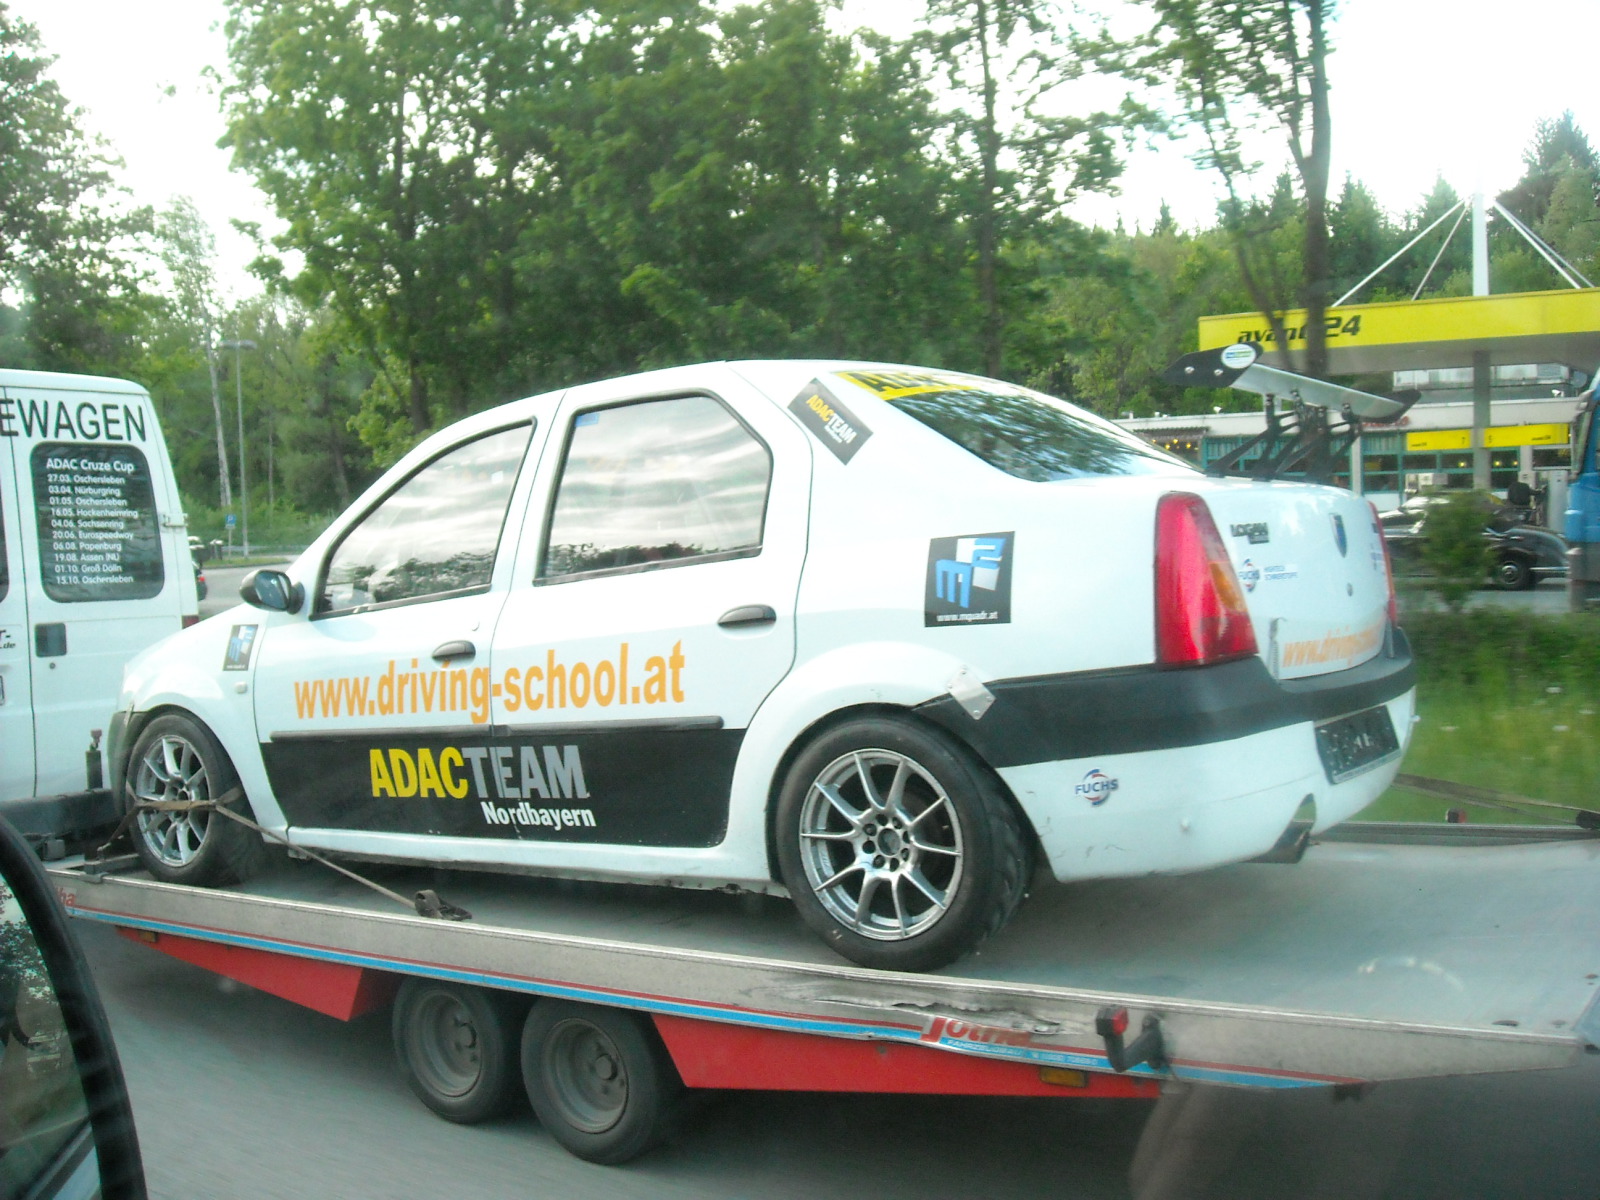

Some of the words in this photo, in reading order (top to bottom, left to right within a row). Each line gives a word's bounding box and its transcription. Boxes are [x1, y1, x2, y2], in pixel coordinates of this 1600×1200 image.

[0, 398, 146, 442] EWAGEN
[46, 458, 78, 470] ADAC
[80, 459, 111, 472] Cruze
[113, 460, 135, 474] Cup
[73, 474, 126, 484] Oschersleben
[74, 486, 121, 497] Nürburgring
[75, 497, 128, 506] Oschersleben
[76, 508, 138, 519] Hockenheimring
[77, 519, 124, 530] Sachsenring
[78, 531, 134, 541] Eurospeedway
[79, 542, 122, 552] Papenburg
[80, 553, 104, 561] Assen
[82, 575, 134, 584] Oschersleben
[294, 640, 686, 724] www.driving-school.at
[1074, 778, 1119, 795] FUCHS
[480, 801, 597, 831] Nordbayern
